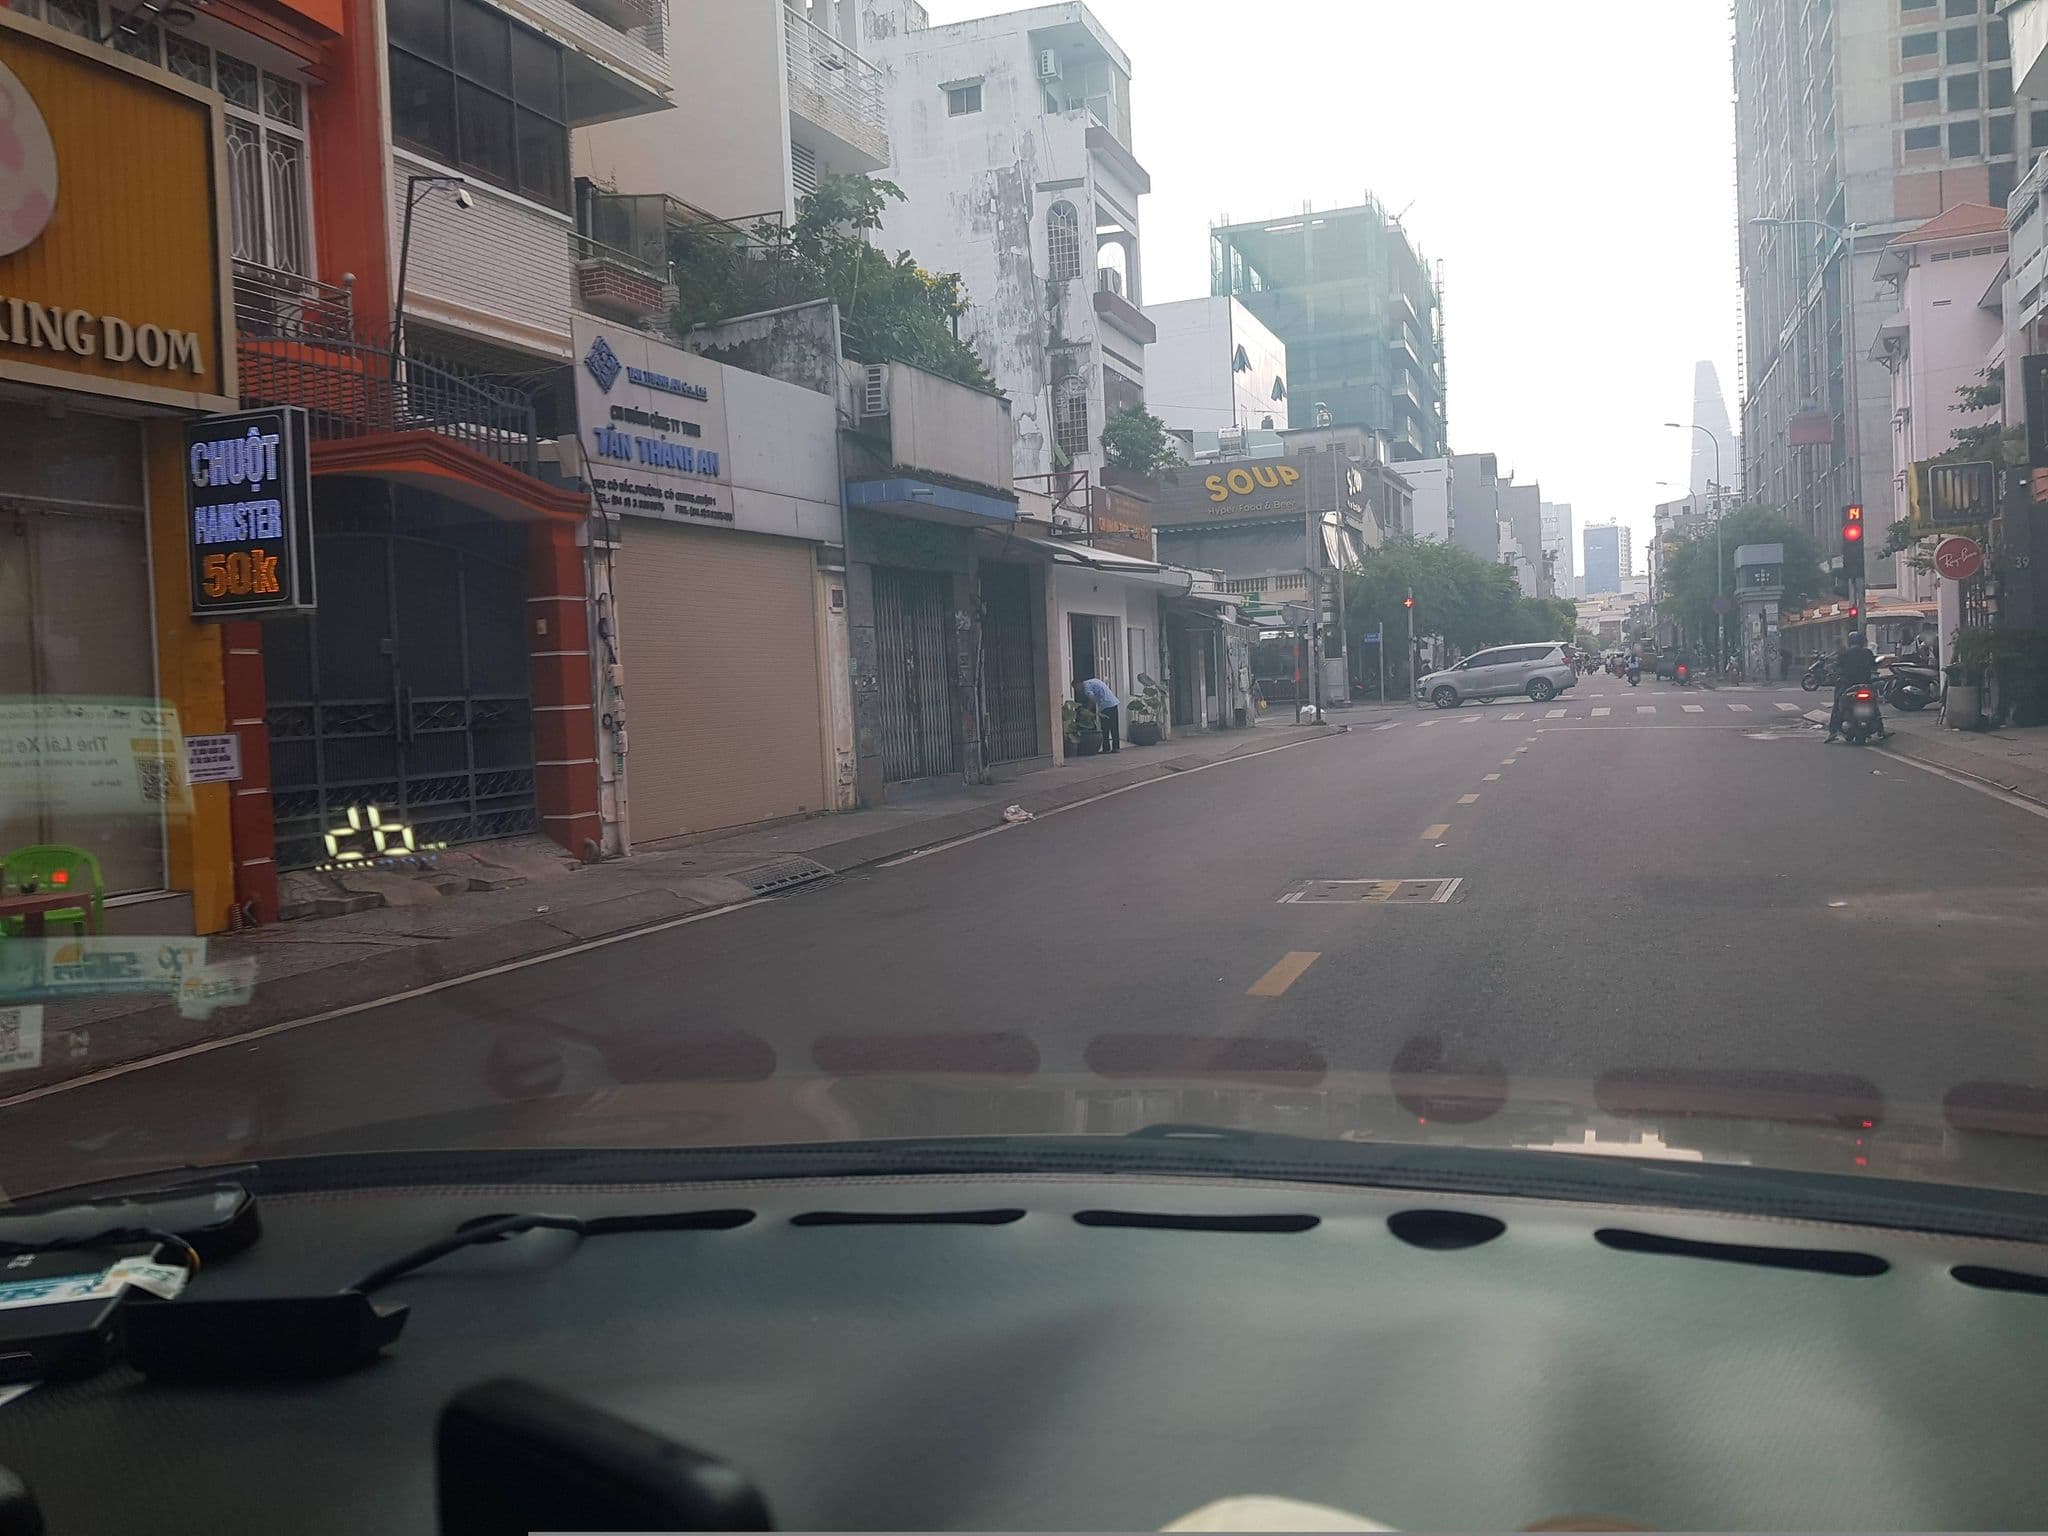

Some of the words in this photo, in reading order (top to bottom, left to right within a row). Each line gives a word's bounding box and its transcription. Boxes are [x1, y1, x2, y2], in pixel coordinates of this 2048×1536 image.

[190, 426, 280, 493] CHUỘT
[697, 448, 720, 478] AN
[1205, 464, 1300, 502] SOUP
[194, 499, 283, 546] HAMSTER
